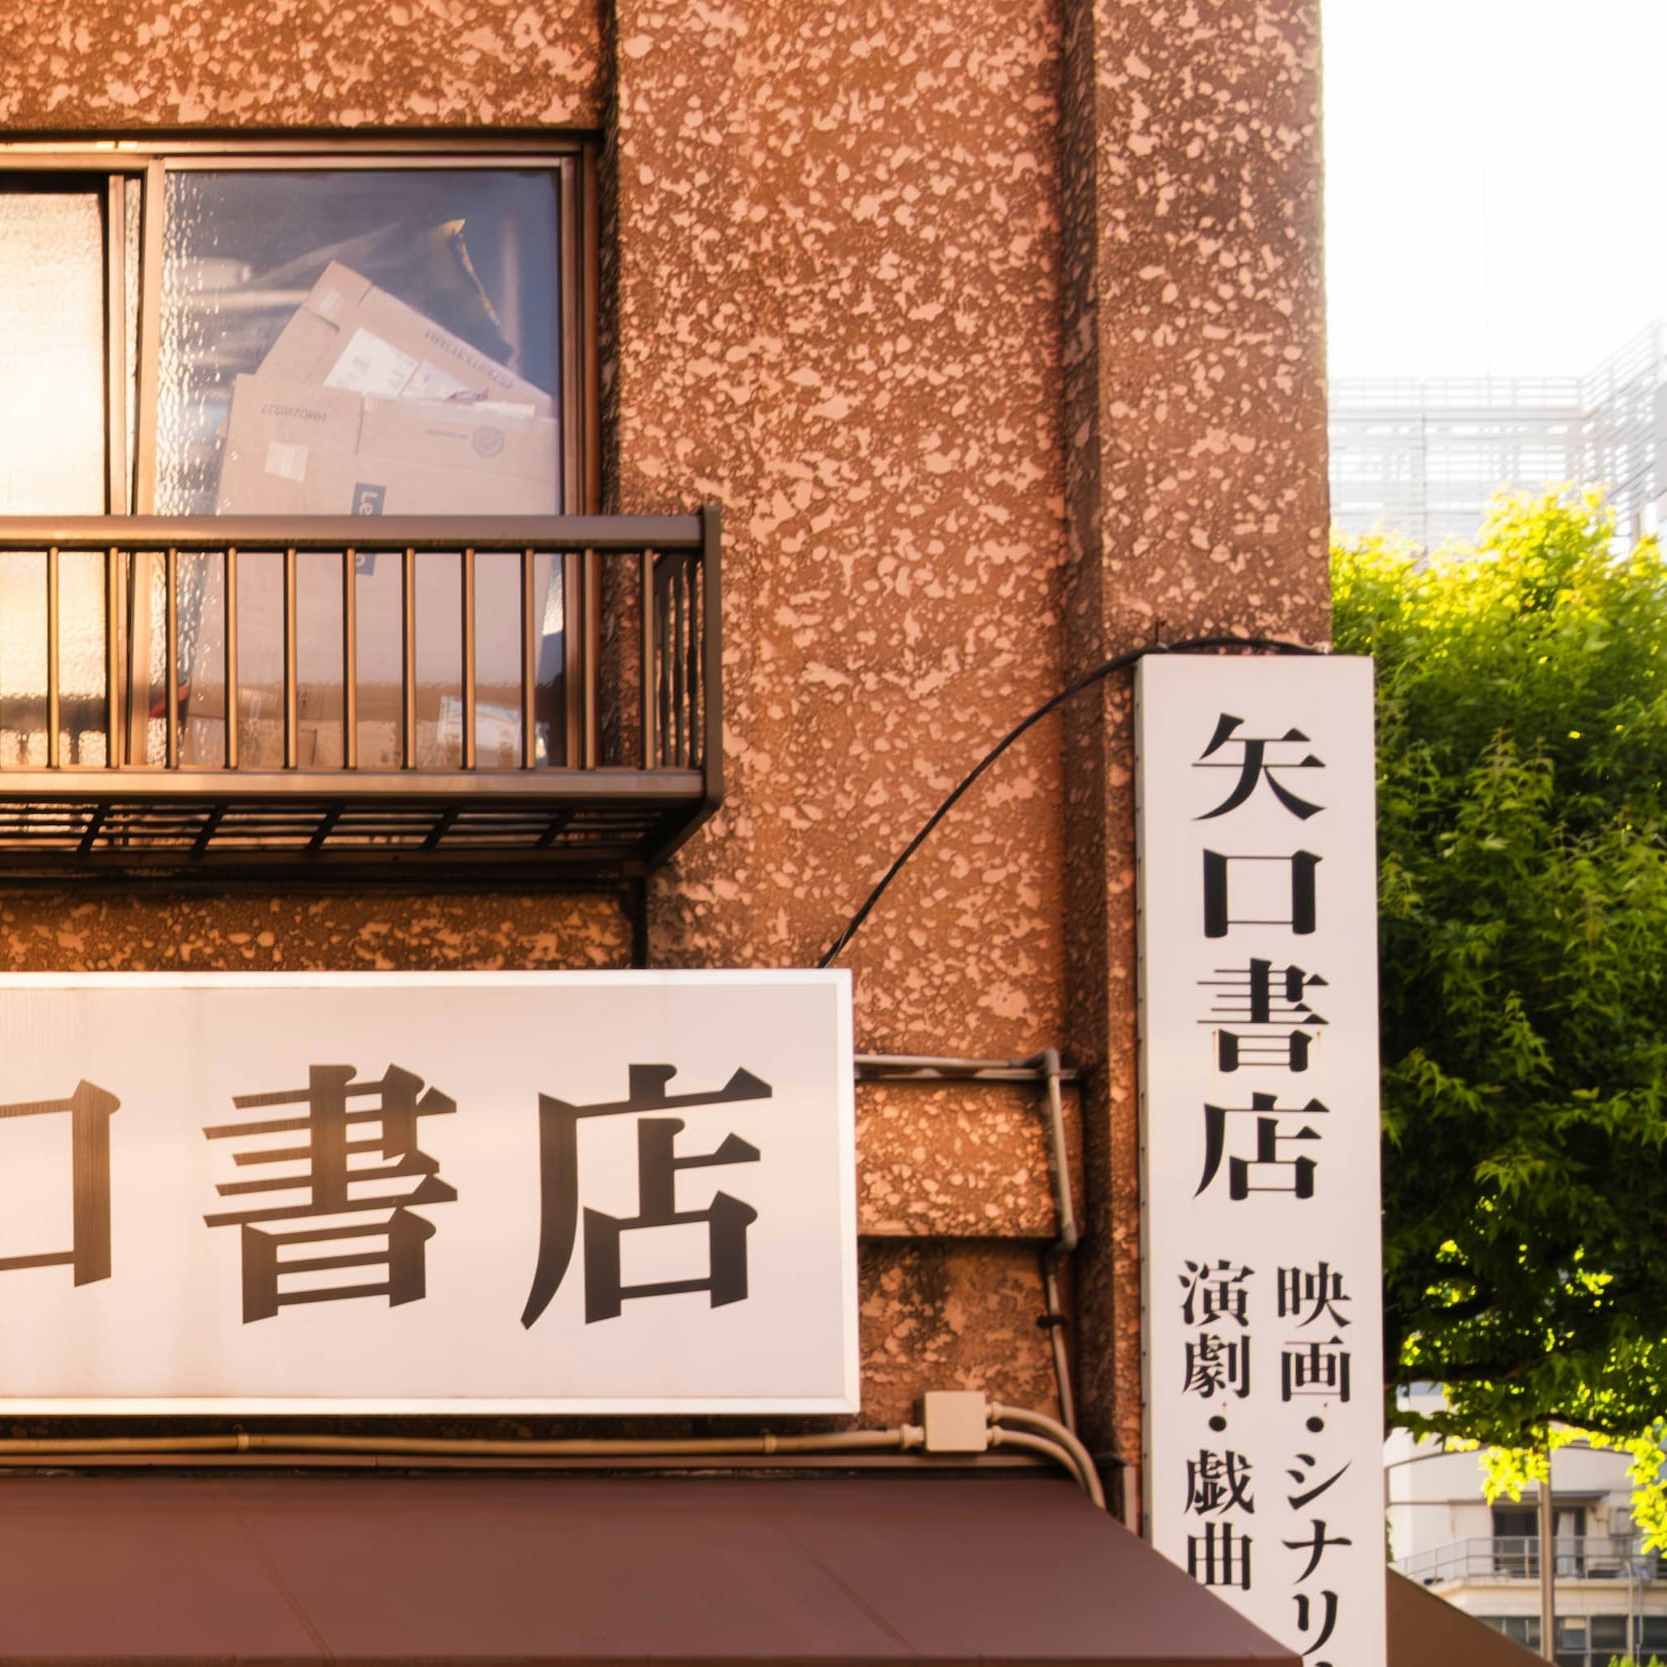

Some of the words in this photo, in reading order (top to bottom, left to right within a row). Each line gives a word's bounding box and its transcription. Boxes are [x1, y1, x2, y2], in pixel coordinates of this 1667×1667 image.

[1192, 713, 1330, 1201] 矢口書店
[1178, 1259, 1254, 1591] 演劇・戯曲
